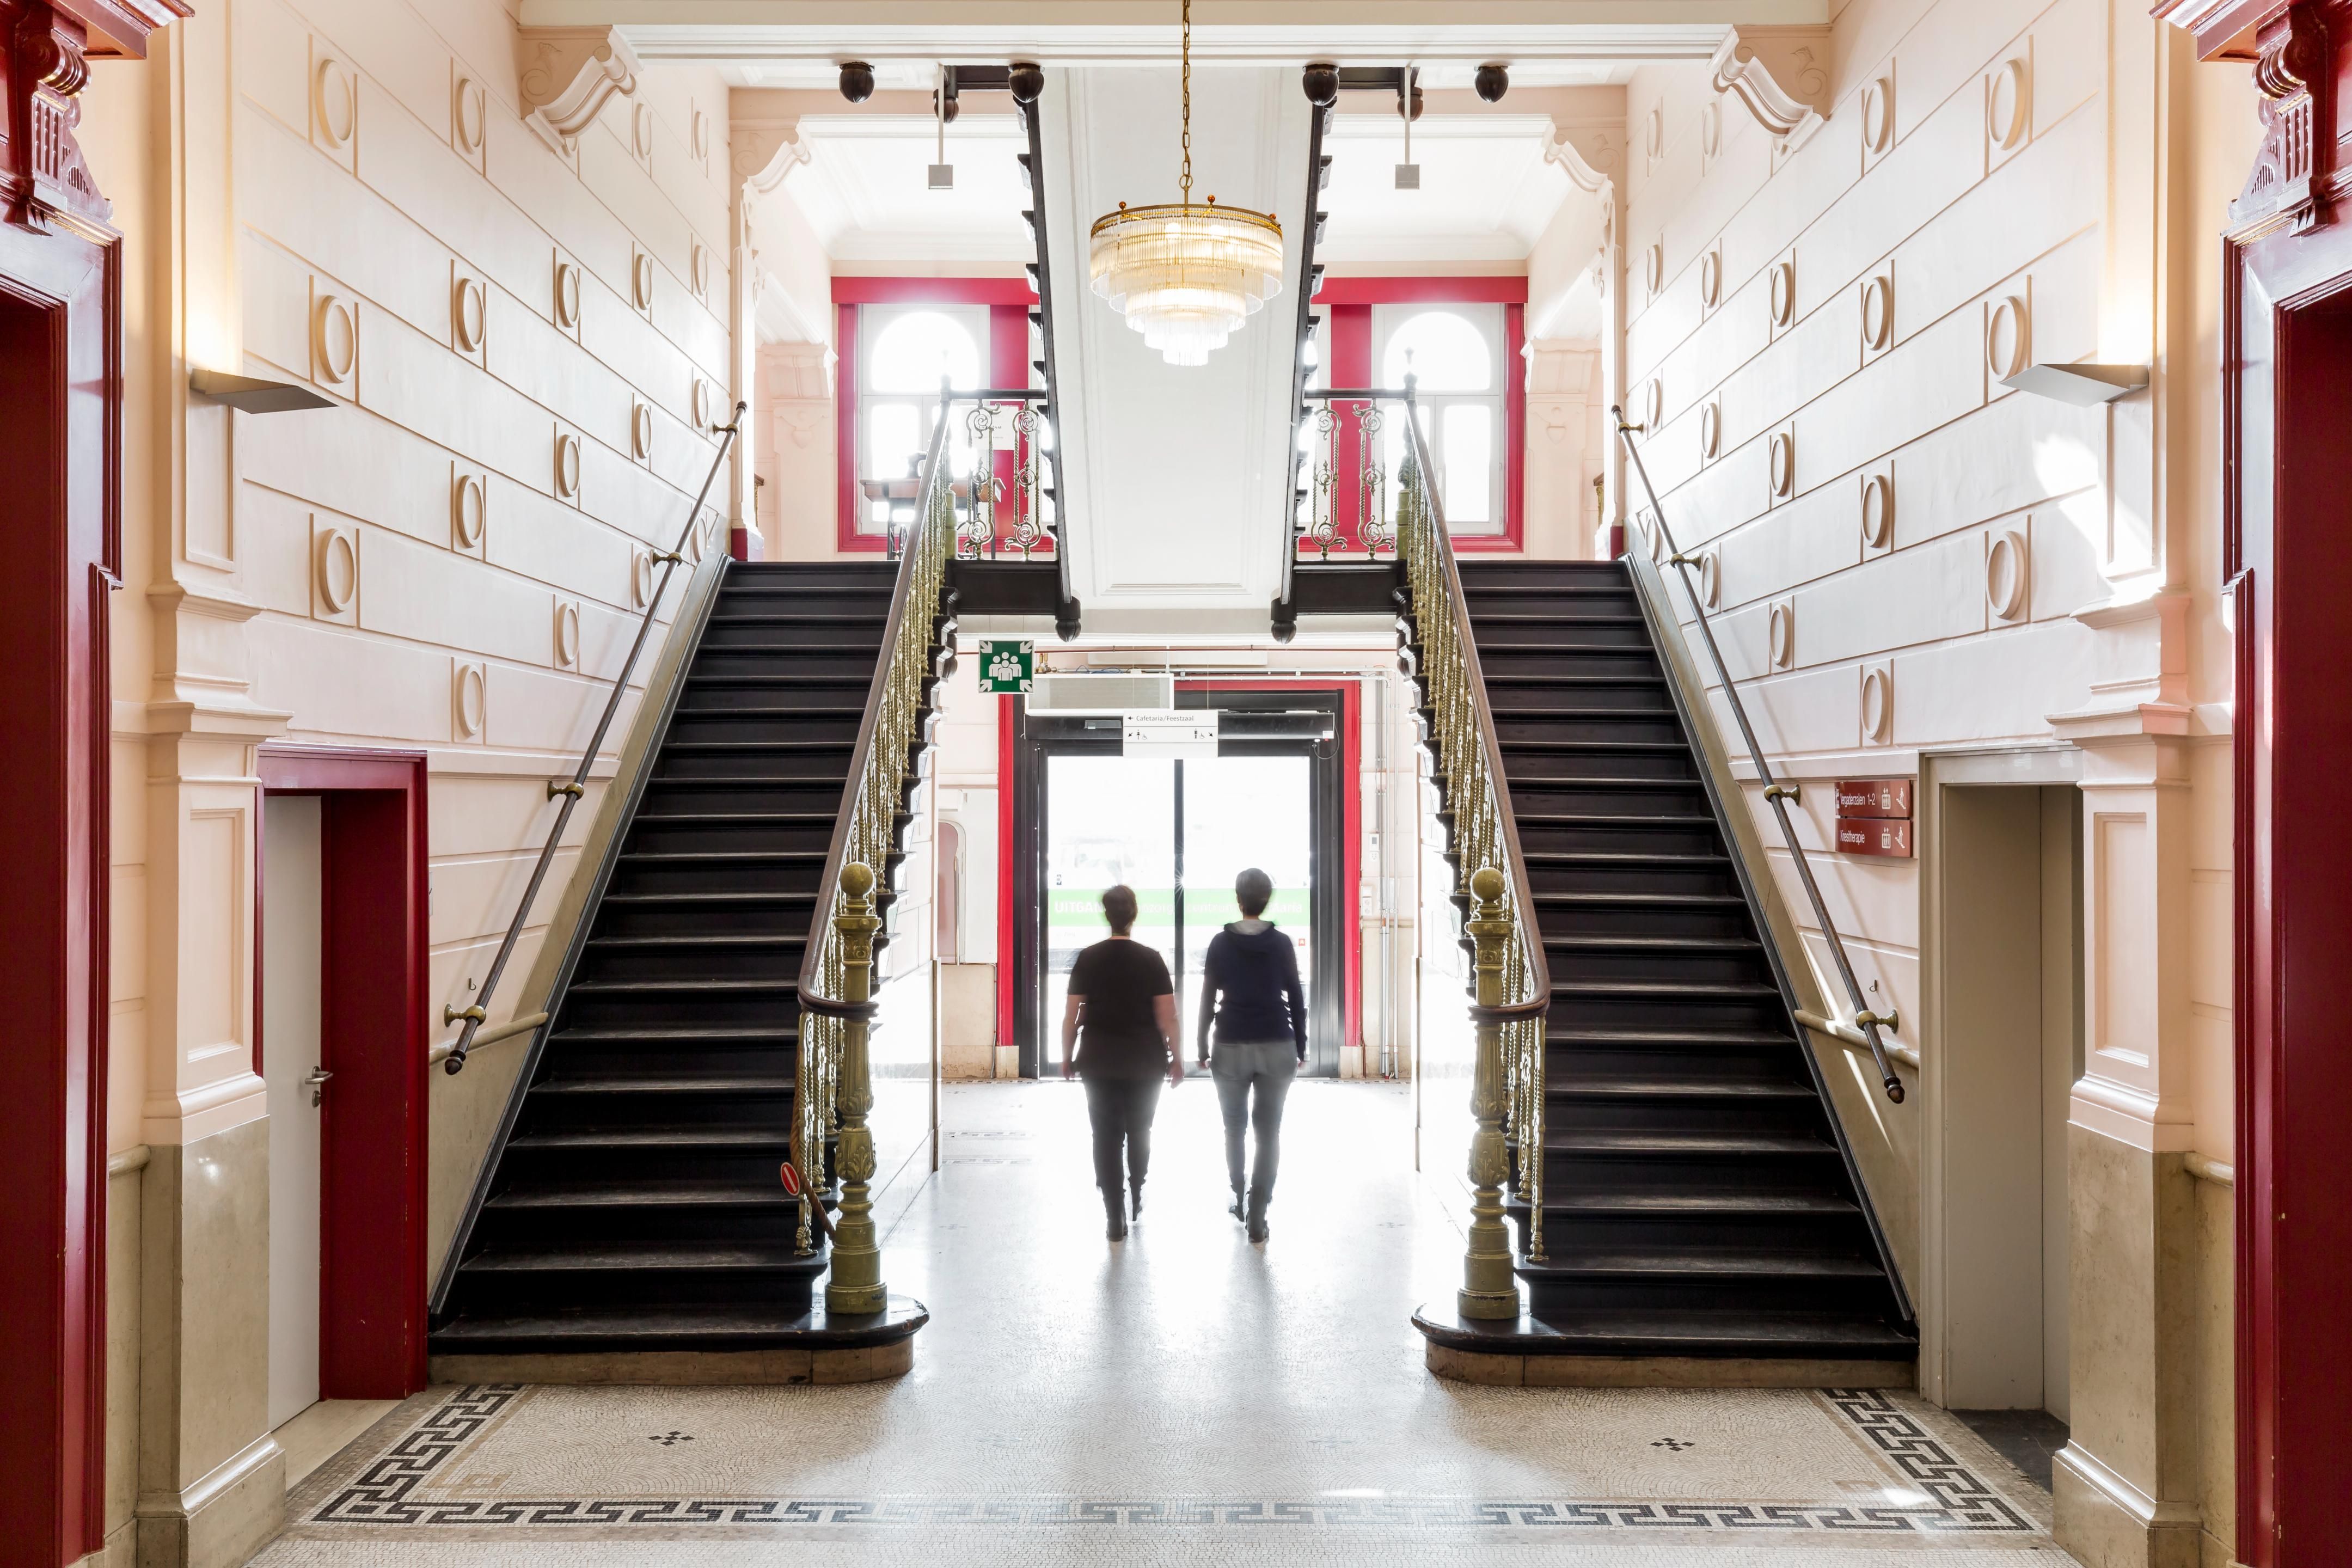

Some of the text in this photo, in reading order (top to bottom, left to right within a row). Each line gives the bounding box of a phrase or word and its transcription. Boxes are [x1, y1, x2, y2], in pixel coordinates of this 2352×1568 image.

[1840, 793, 1876, 807] Vergaderzalen 1-2
[1840, 830, 1865, 845] Kinesitherapie
[1055, 901, 1105, 913] UITGAN
